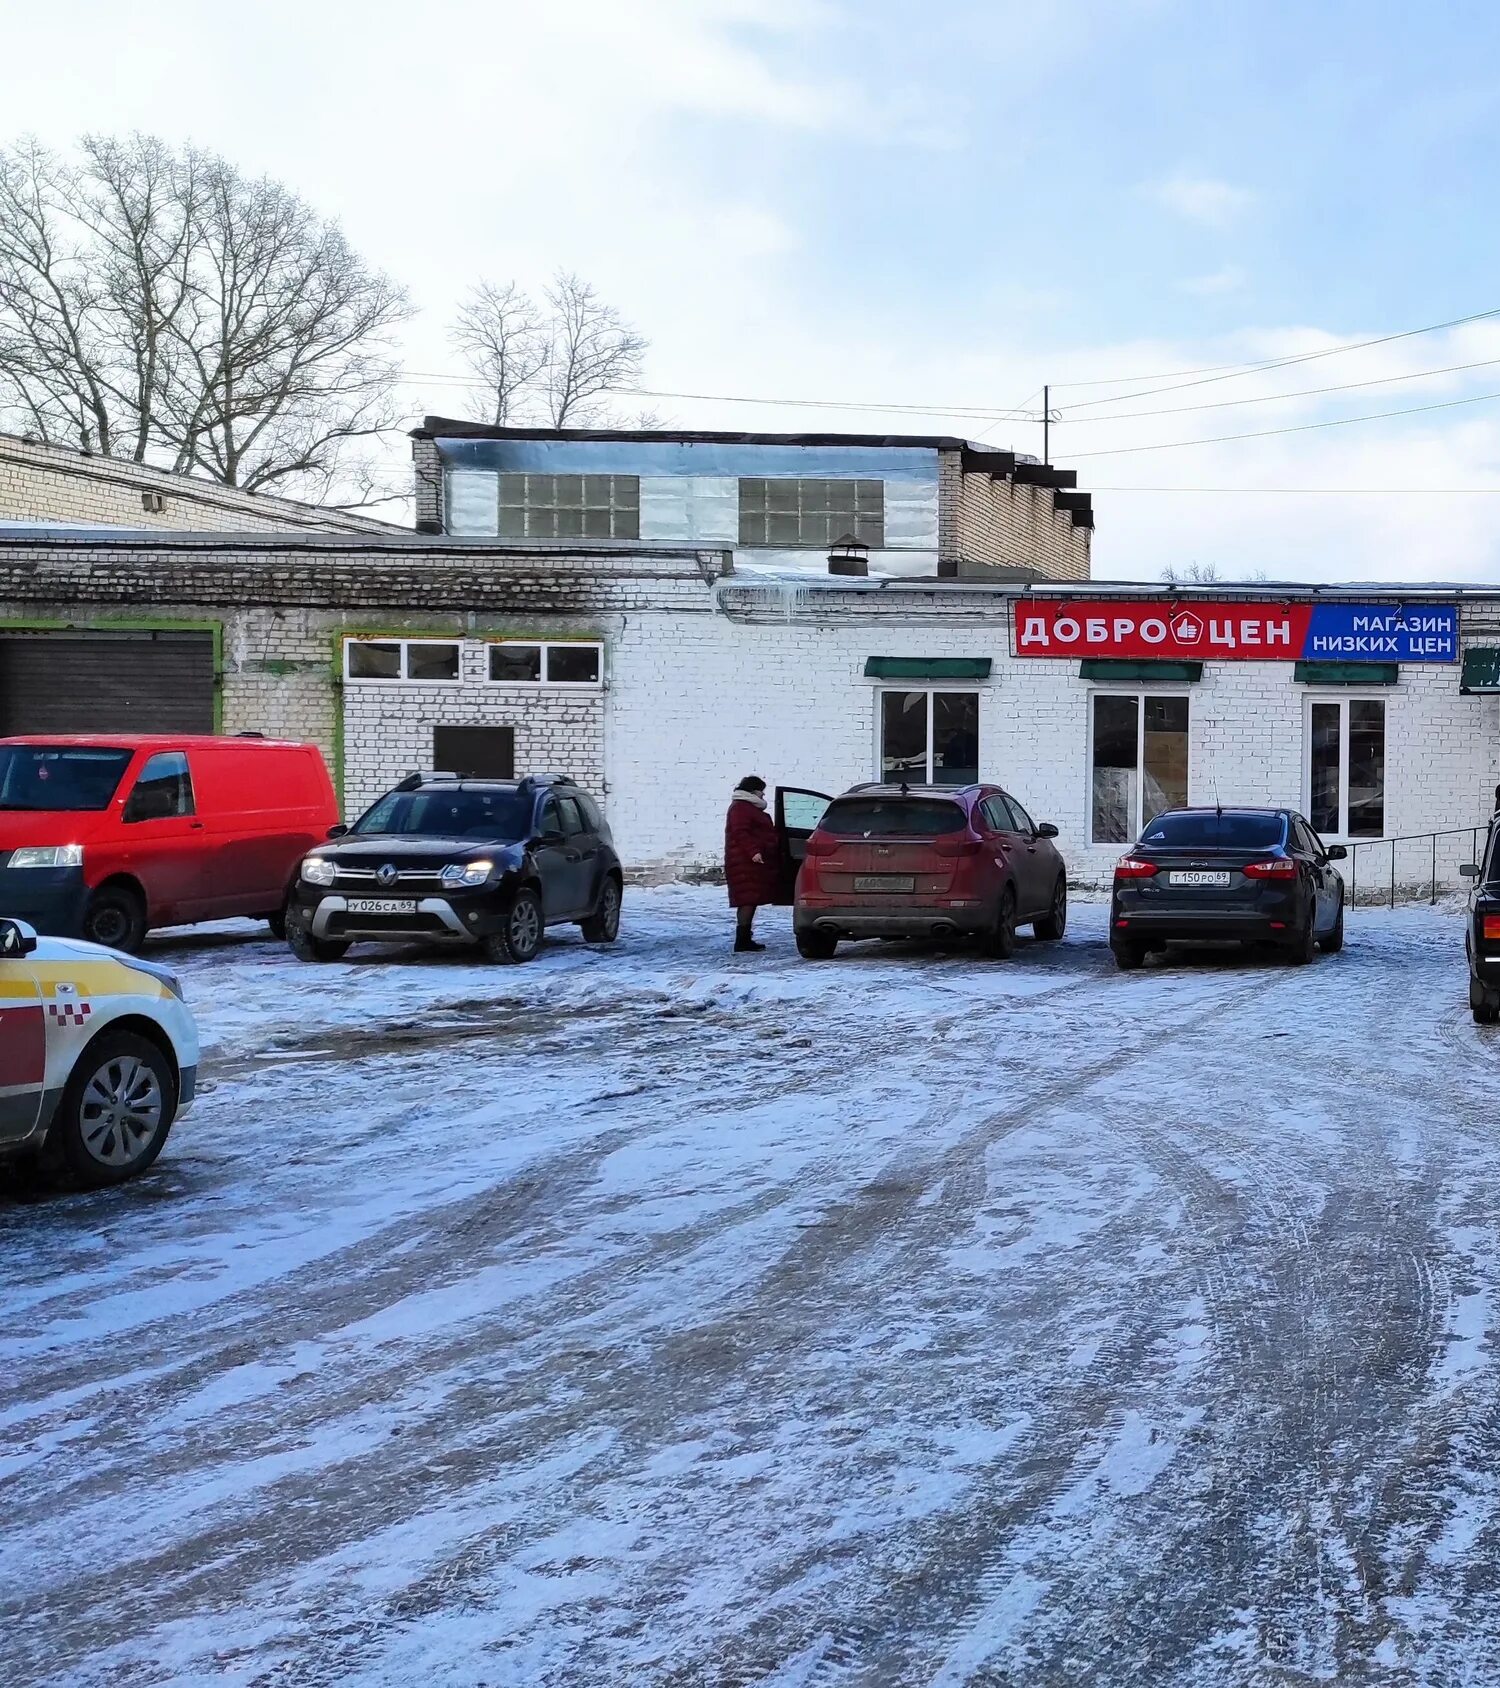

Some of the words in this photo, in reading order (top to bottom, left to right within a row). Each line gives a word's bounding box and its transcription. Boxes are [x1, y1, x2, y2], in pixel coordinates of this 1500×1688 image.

[1021, 617, 1167, 646] ДОБРО
[1353, 616, 1451, 632] МАГАЗИН
[1313, 636, 1398, 652] НИЗКИХ
[1409, 637, 1451, 655] ЦЕН
